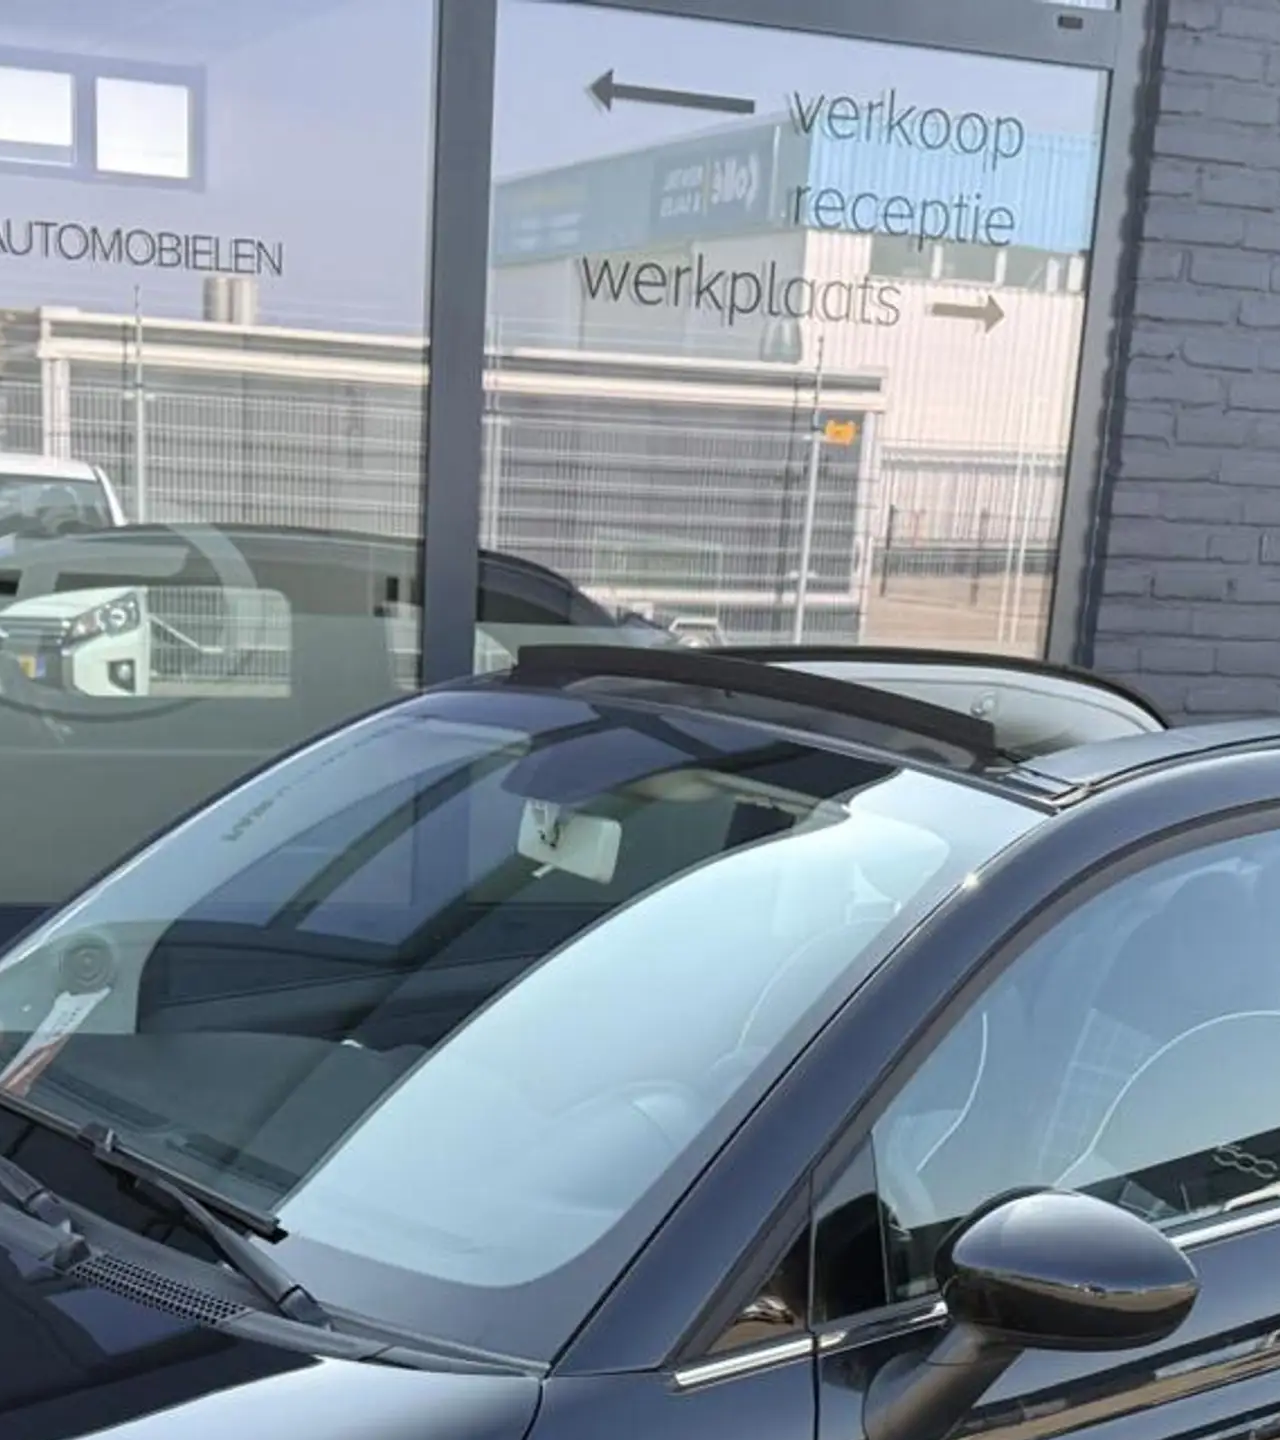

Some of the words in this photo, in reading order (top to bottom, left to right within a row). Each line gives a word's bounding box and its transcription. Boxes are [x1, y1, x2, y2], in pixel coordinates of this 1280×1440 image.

[792, 88, 1025, 172] verkoop
[793, 185, 1016, 252] receptie
[581, 253, 902, 326] werkplaats
